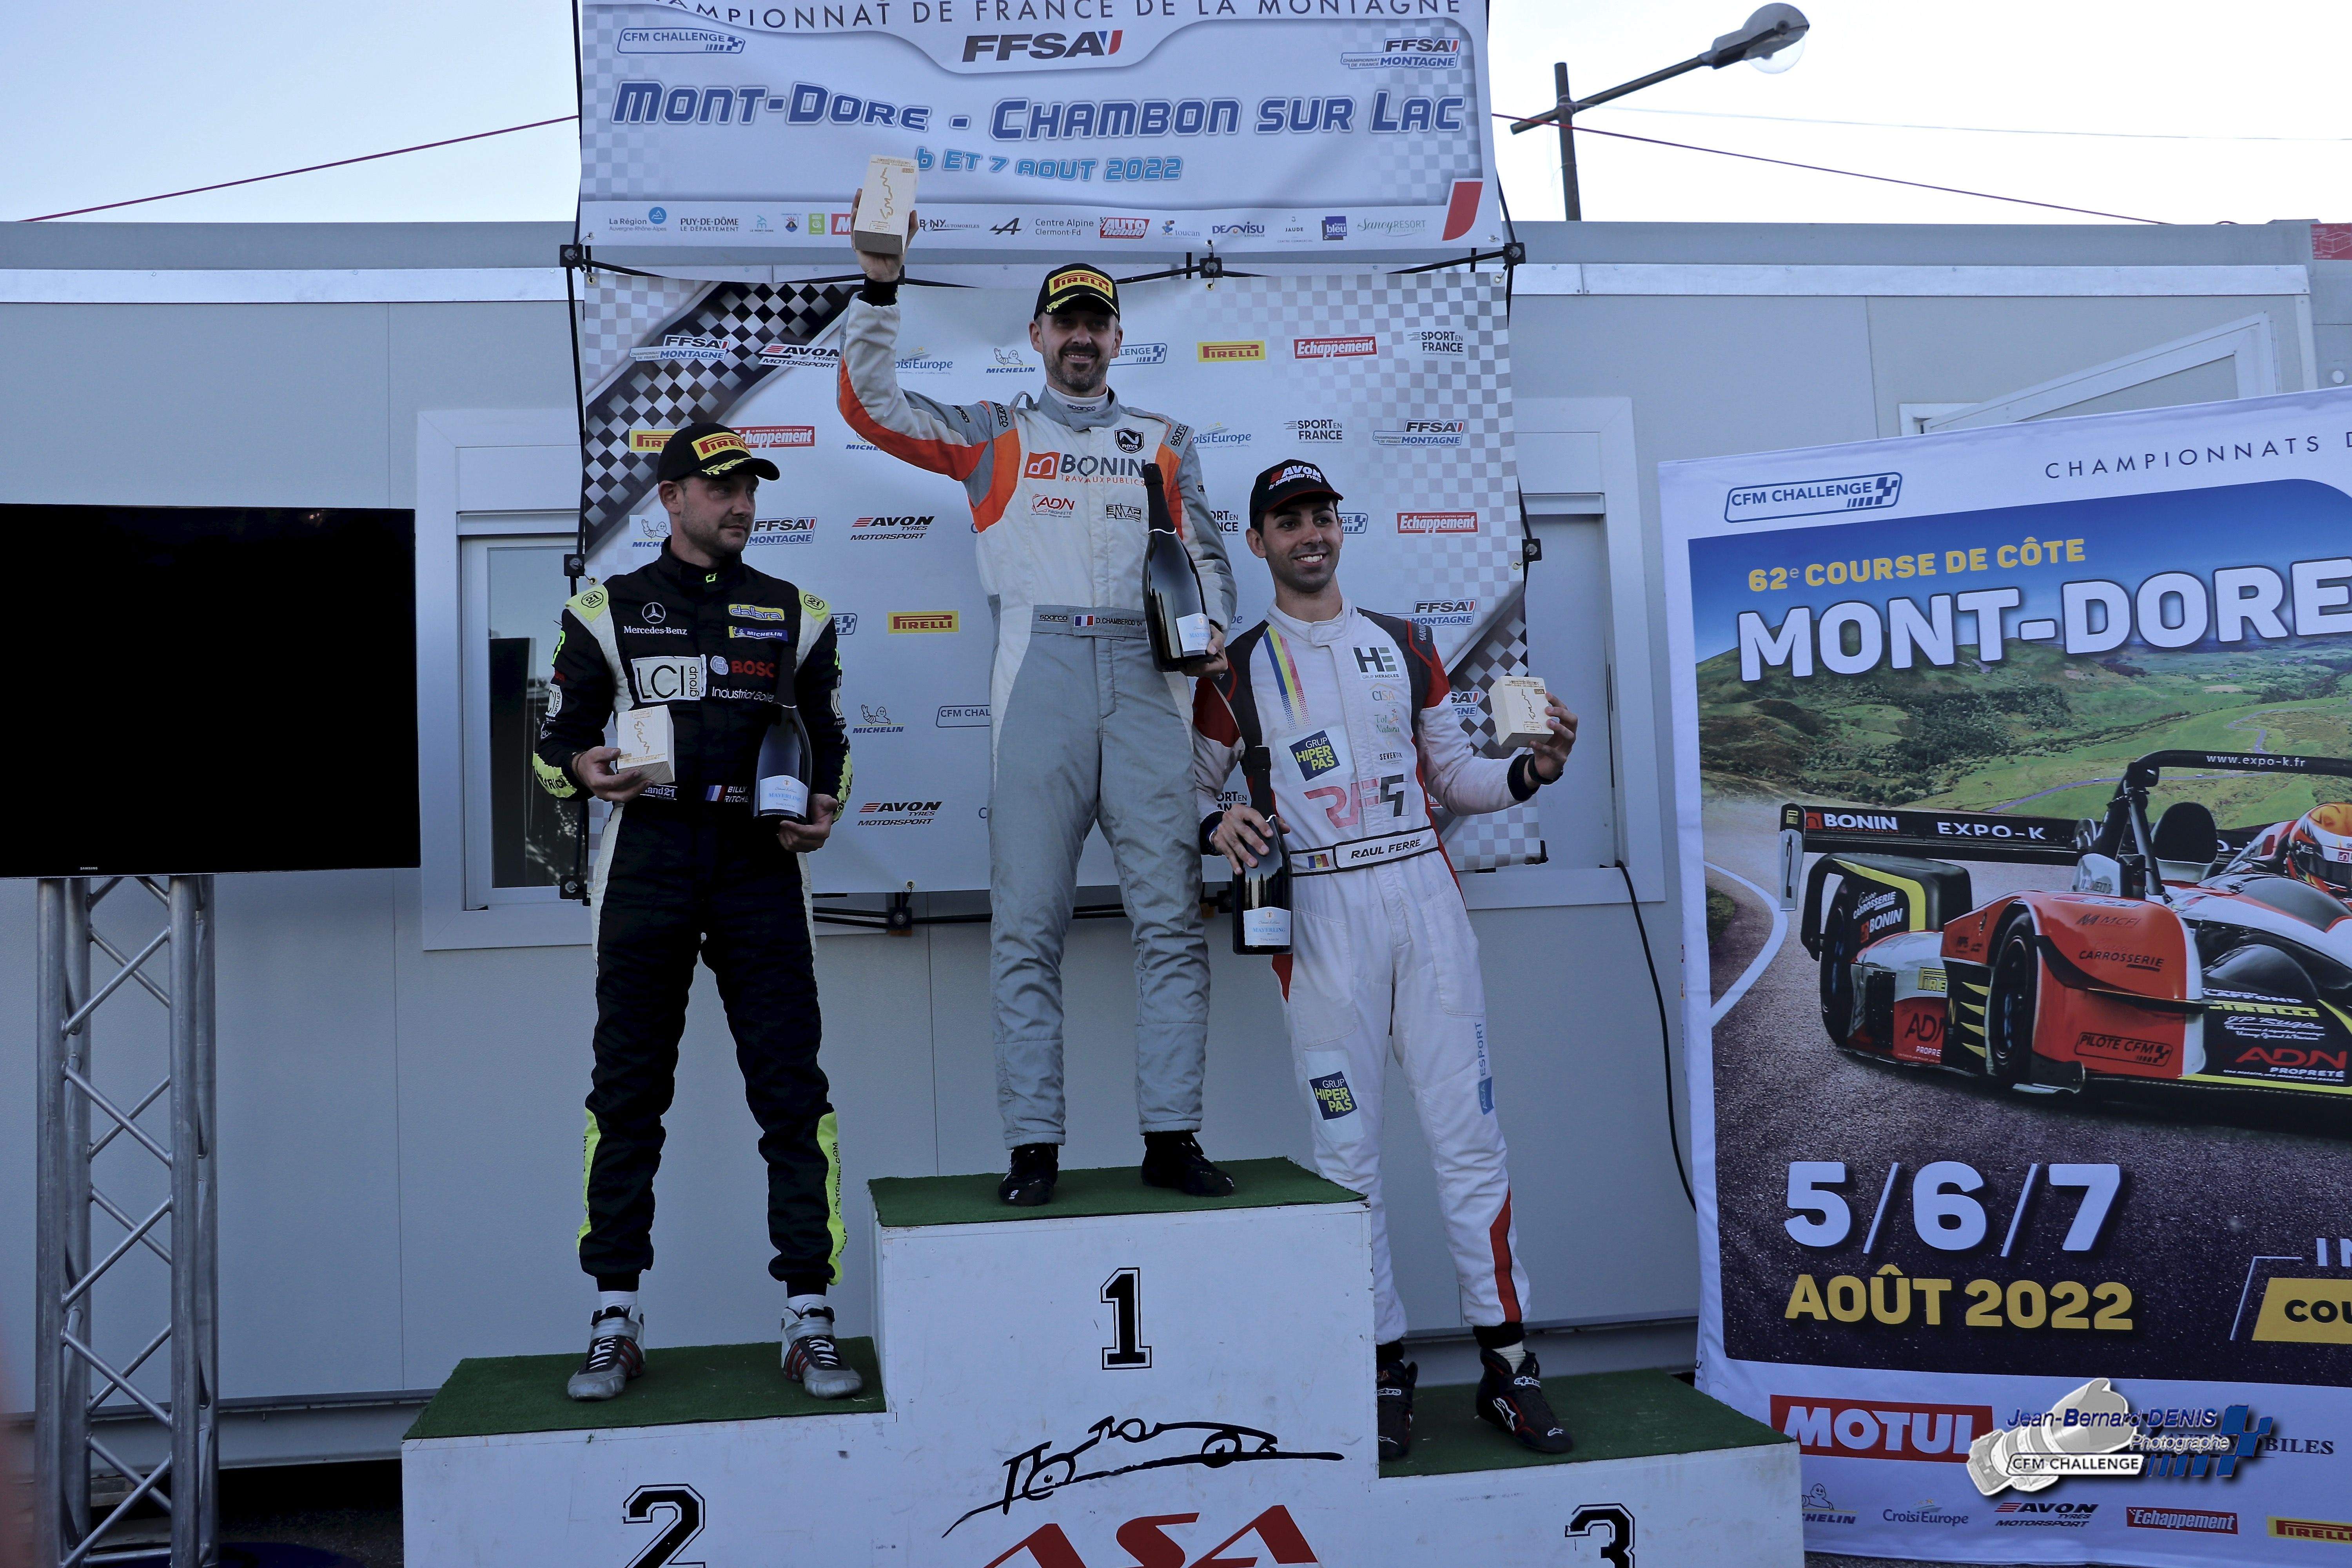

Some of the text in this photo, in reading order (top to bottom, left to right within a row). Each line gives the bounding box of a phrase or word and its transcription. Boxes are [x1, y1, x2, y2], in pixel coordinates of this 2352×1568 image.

[913, 1, 952, 23] DE
[976, 0, 1113, 21] FRANCE
[623, 32, 725, 42] CFM CHALLENGE
[962, 31, 1104, 62] FFSA
[1385, 39, 1450, 53] FFSA
[1380, 57, 1455, 67] MONTAGNE
[943, 149, 982, 171] ET
[989, 156, 1008, 173] 7
[1016, 158, 1098, 181] AOUT
[1103, 158, 1182, 182] 2022
[619, 218, 647, 226] Région
[680, 216, 739, 226] PUY-DE-DÔME
[1066, 219, 1094, 228] Alpine
[1106, 219, 1146, 229] AUTO
[1393, 220, 1426, 229] RESORT
[1104, 227, 1145, 237] hebdo
[1327, 225, 1346, 234] bleu
[1053, 272, 1109, 292] PIRELLI
[667, 337, 722, 348] FFSA
[1421, 331, 1455, 341] SPORT
[1203, 345, 1259, 358] PIRELLI
[1297, 340, 1374, 358] Echappement
[1422, 342, 1463, 352] FRANCE
[660, 350, 724, 359] MONTAGNE
[762, 358, 837, 368] MOTORSPORT
[1298, 419, 1332, 429] SPORT
[1406, 421, 1457, 432] FFSA
[1299, 430, 1342, 440] FRANCE
[2046, 435, 2320, 479] CHAMPIONNATS
[1060, 454, 1145, 478] BONIN
[1281, 465, 1321, 479] AVON
[1307, 474, 1321, 483] TYRES
[1730, 480, 1873, 509] CFM CHALLENGE
[1036, 497, 1075, 510] ADN
[754, 518, 811, 532] FFSA
[869, 516, 935, 526] AVON
[1400, 515, 1475, 534] Echappement
[1805, 551, 1936, 587] COURSE
[1945, 548, 1987, 573] DE
[1996, 536, 2085, 568] CÔTE
[731, 605, 782, 620] dallara
[1415, 602, 1468, 613] FFSA
[893, 615, 953, 630] PIRELLI
[1039, 614, 1068, 622] sparco
[1736, 555, 2352, 683] MONT-DORE
[624, 627, 688, 636] Mercedes-Benz
[637, 665, 684, 699] LCI
[689, 666, 699, 697] group
[711, 686, 753, 699] Industrial
[1372, 690, 1395, 701] CISA
[941, 710, 962, 718] CFM
[1374, 714, 1387, 723] Tot
[1376, 725, 1400, 734] Natura
[1305, 737, 1328, 748] GRUP
[1296, 745, 1332, 764] HIPER
[1311, 755, 1334, 771] PAS
[2206, 755, 2306, 768] www.expo-k.fr
[878, 801, 942, 812] AVON
[857, 818, 934, 826] MOTORSPORT
[1824, 813, 1898, 830] BONIN
[1937, 822, 2046, 840] EXPO-K
[1350, 836, 1421, 859] RAUL FERRÉ
[1869, 908, 1903, 933] BONIN
[2079, 951, 2165, 967] CARROSSERIE
[2079, 1034, 2153, 1054] PILOTE CFM
[2235, 1047, 2348, 1069] ADN
[2269, 1067, 2345, 1078] PROPRETÉ
[1322, 1078, 1345, 1089] GRUP
[1314, 1087, 1350, 1101] HIPER
[1328, 1099, 1353, 1112] PAS
[1784, 1263, 2133, 1331] AOÛT 2022
[1100, 1267, 1152, 1370] 1
[1784, 1405, 1973, 1454] MOTUL
[2018, 1503, 2099, 1514] AVON
[1883, 1508, 1969, 1527] CroisiEurope
[2133, 1509, 2235, 1531] Echappement
[622, 1483, 705, 1568] 2
[982, 1504, 1318, 1568] ASA
[1564, 1503, 1635, 1568] 3
